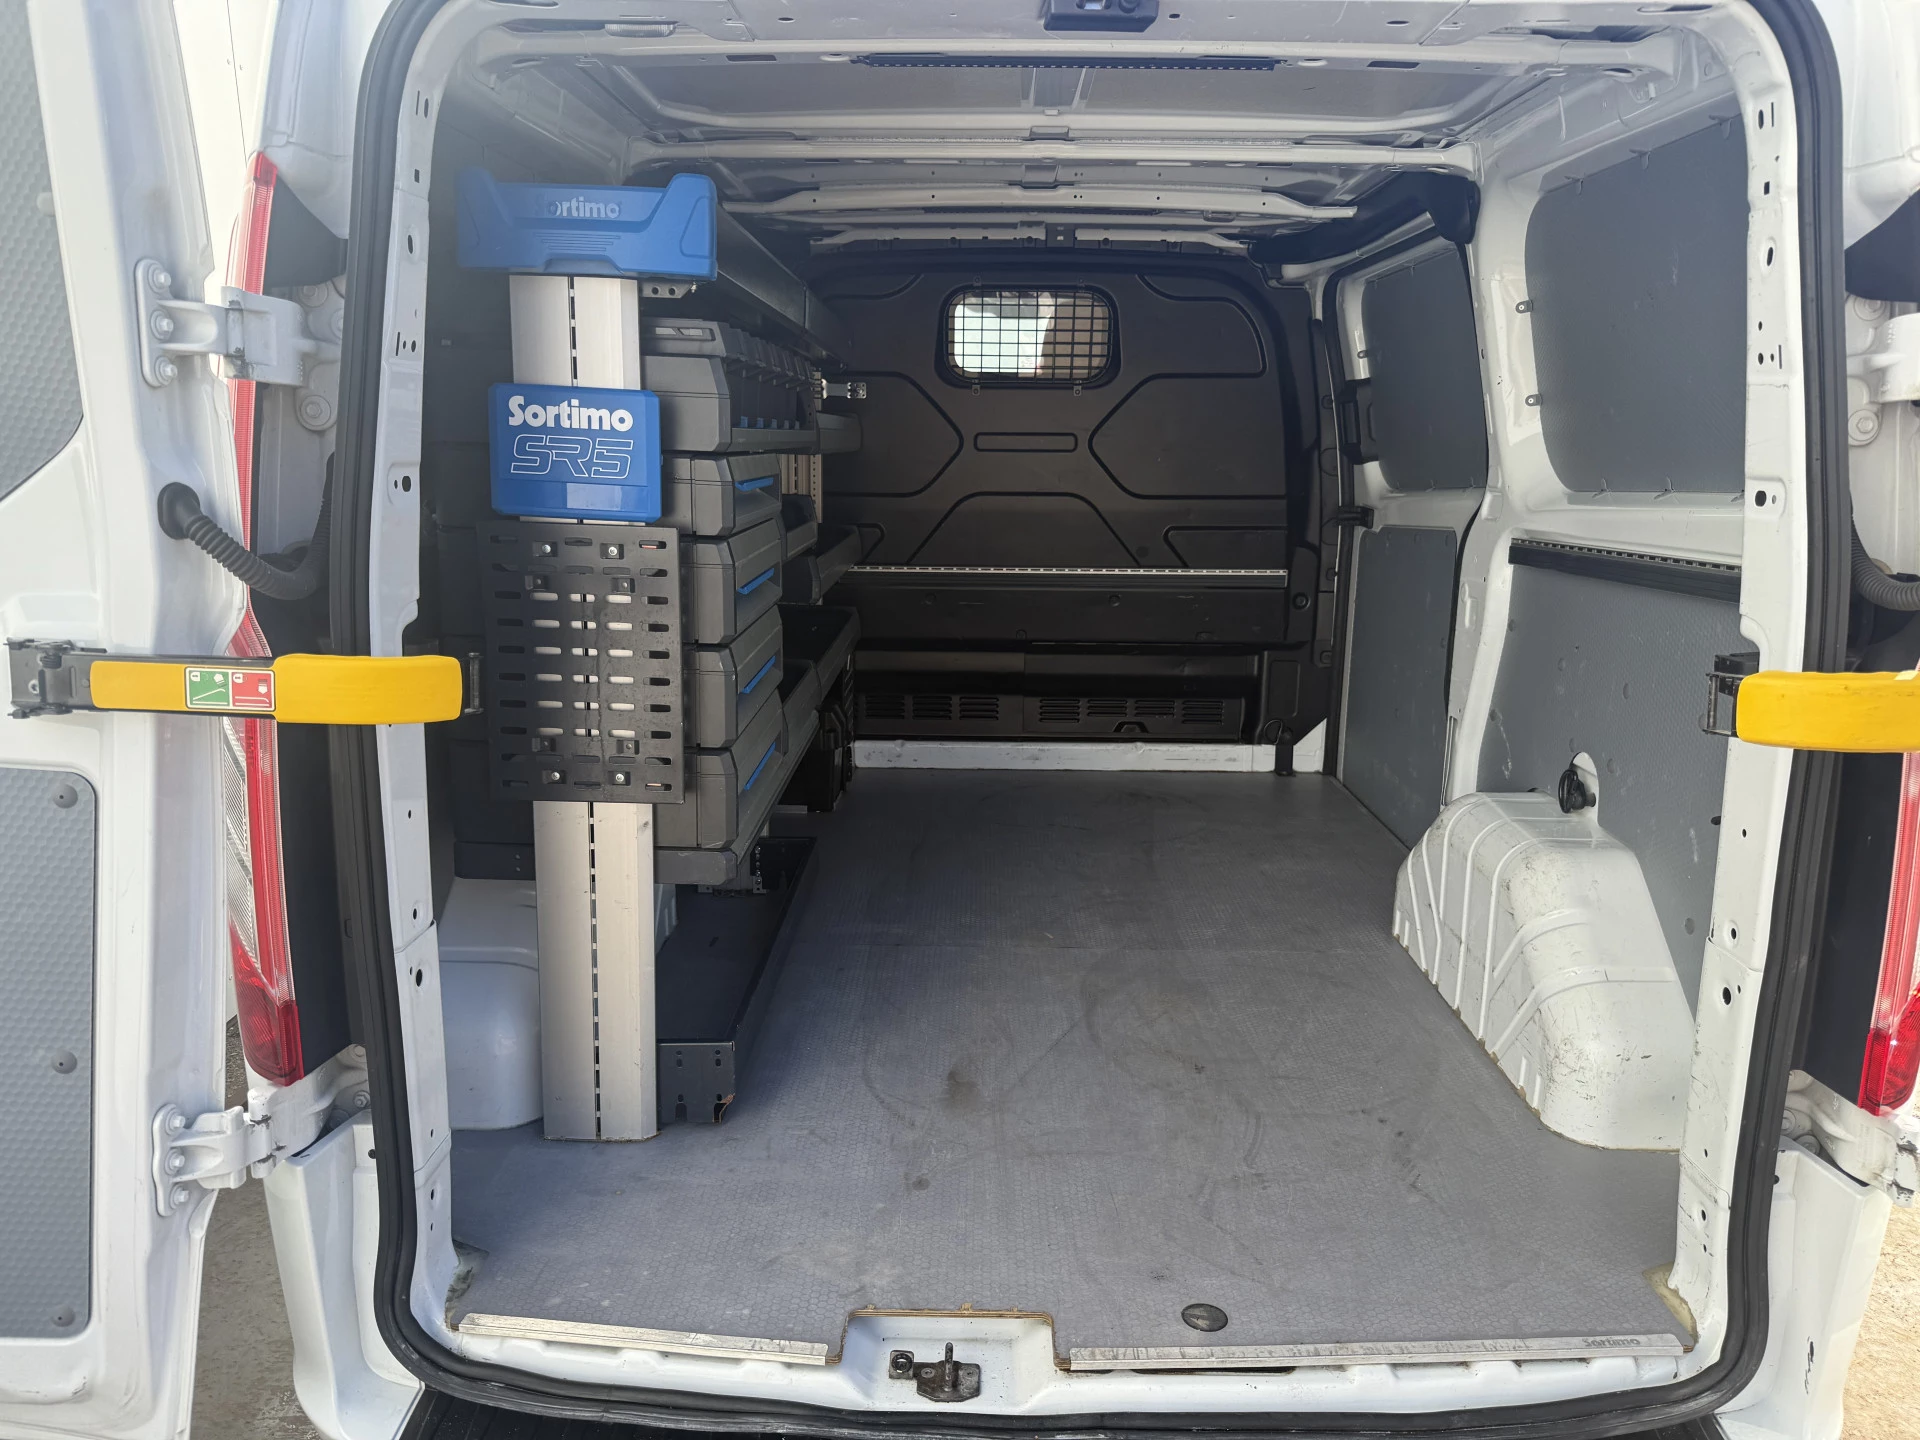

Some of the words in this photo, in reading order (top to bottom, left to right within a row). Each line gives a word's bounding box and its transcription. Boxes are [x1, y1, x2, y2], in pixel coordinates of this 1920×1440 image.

[508, 395, 634, 432] Sortimo
[510, 433, 634, 479] SR5
[1582, 1337, 1641, 1348] Sortimo
